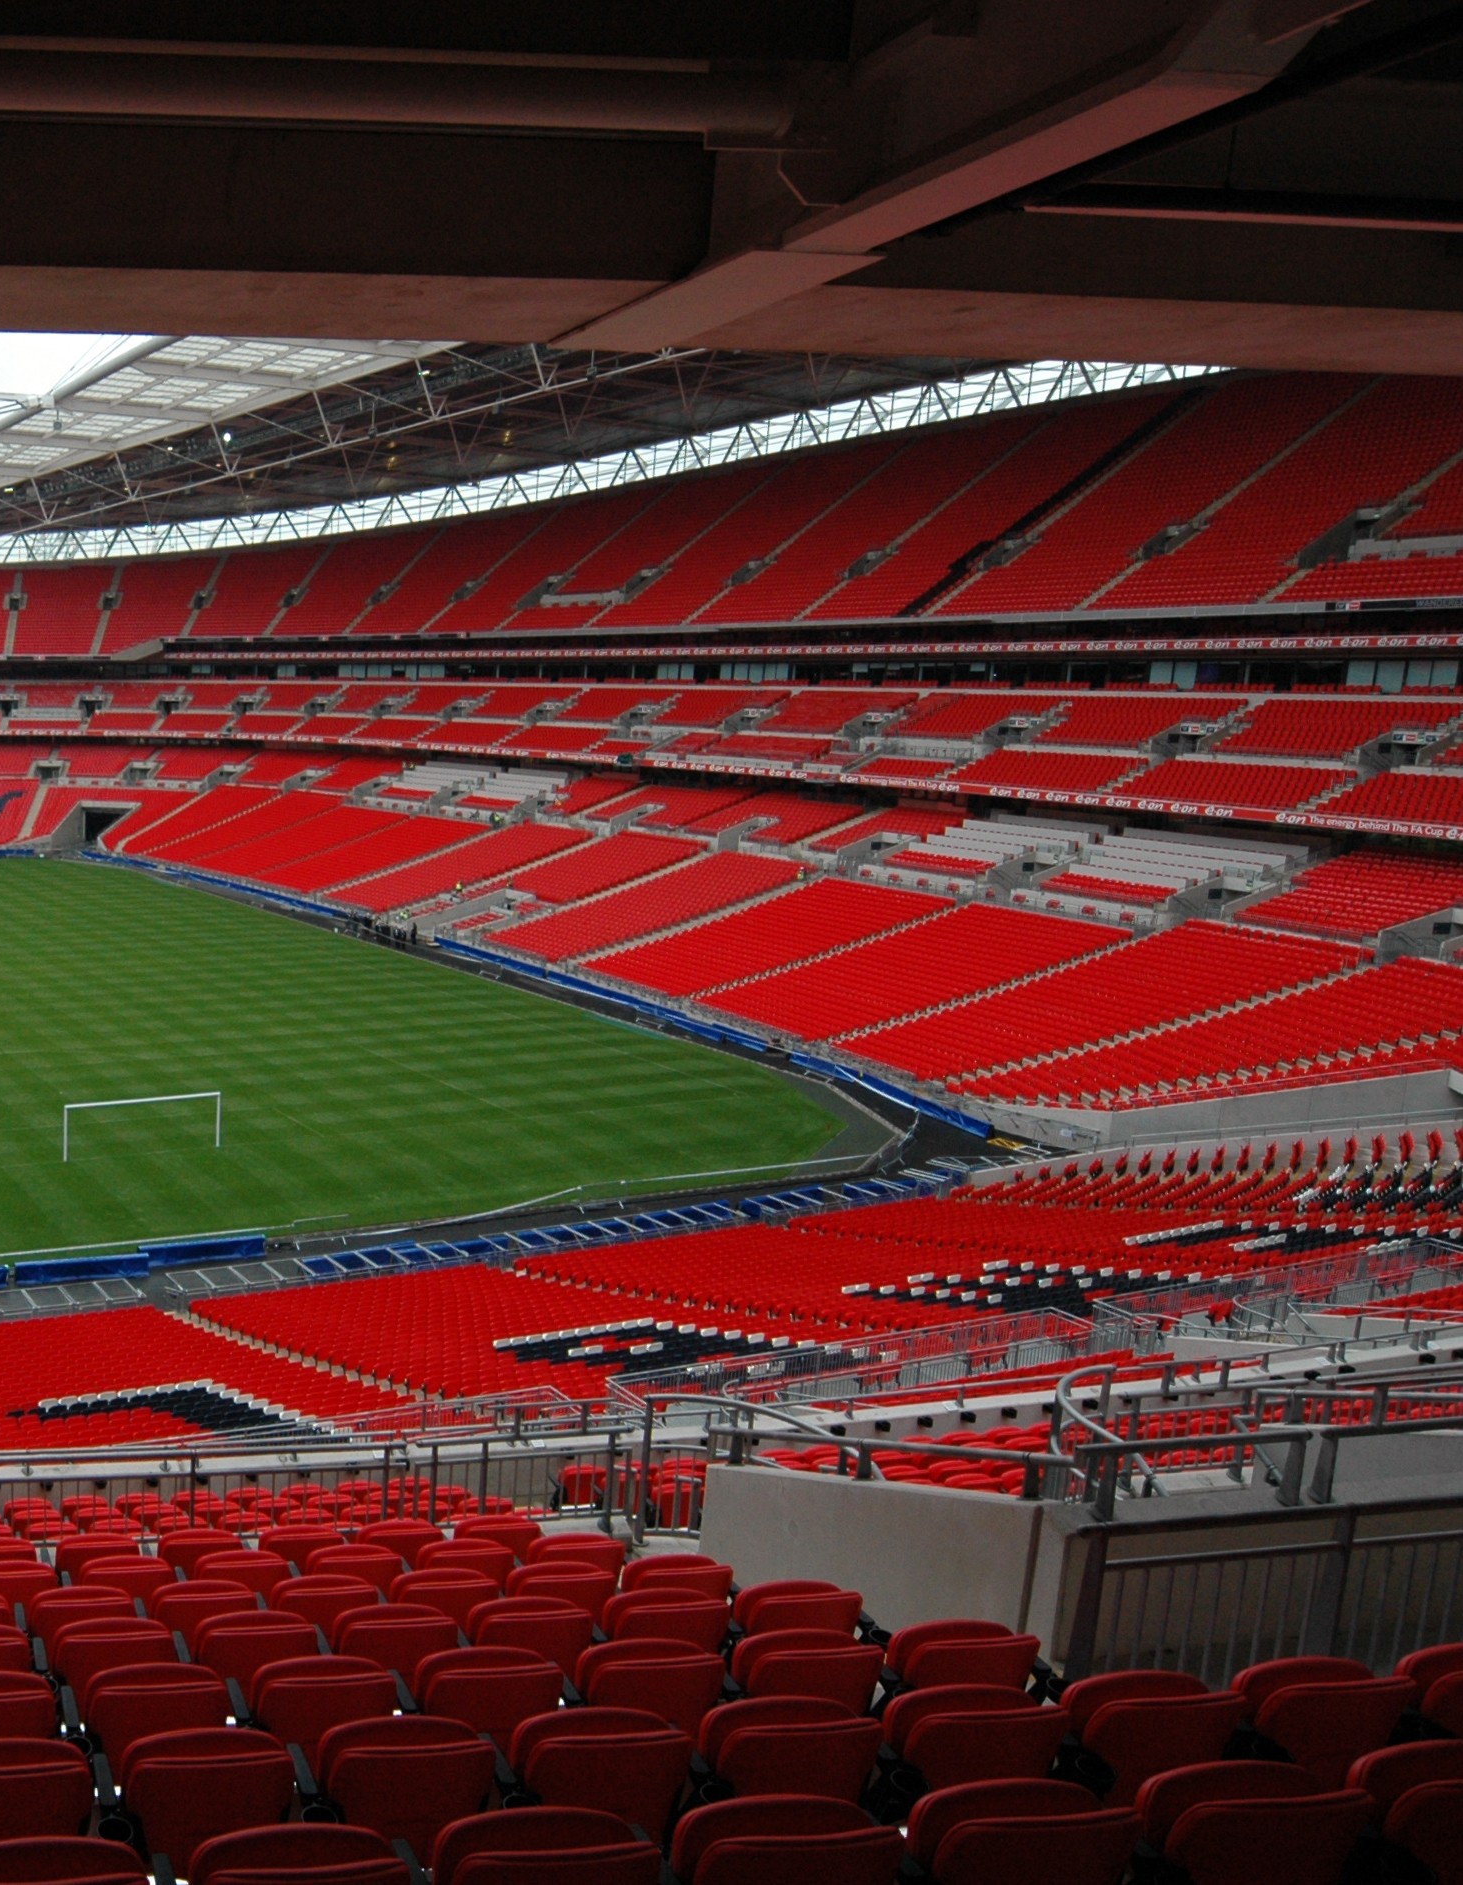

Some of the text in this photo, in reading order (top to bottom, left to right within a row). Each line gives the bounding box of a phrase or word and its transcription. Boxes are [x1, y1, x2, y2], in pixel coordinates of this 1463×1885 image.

[1309, 815, 1325, 825] The
[1326, 818, 1356, 830] energy
[1358, 818, 1390, 832] behind
[1392, 822, 1409, 833] The
[1410, 824, 1423, 834] FA
[1424, 825, 1443, 838] Cup
